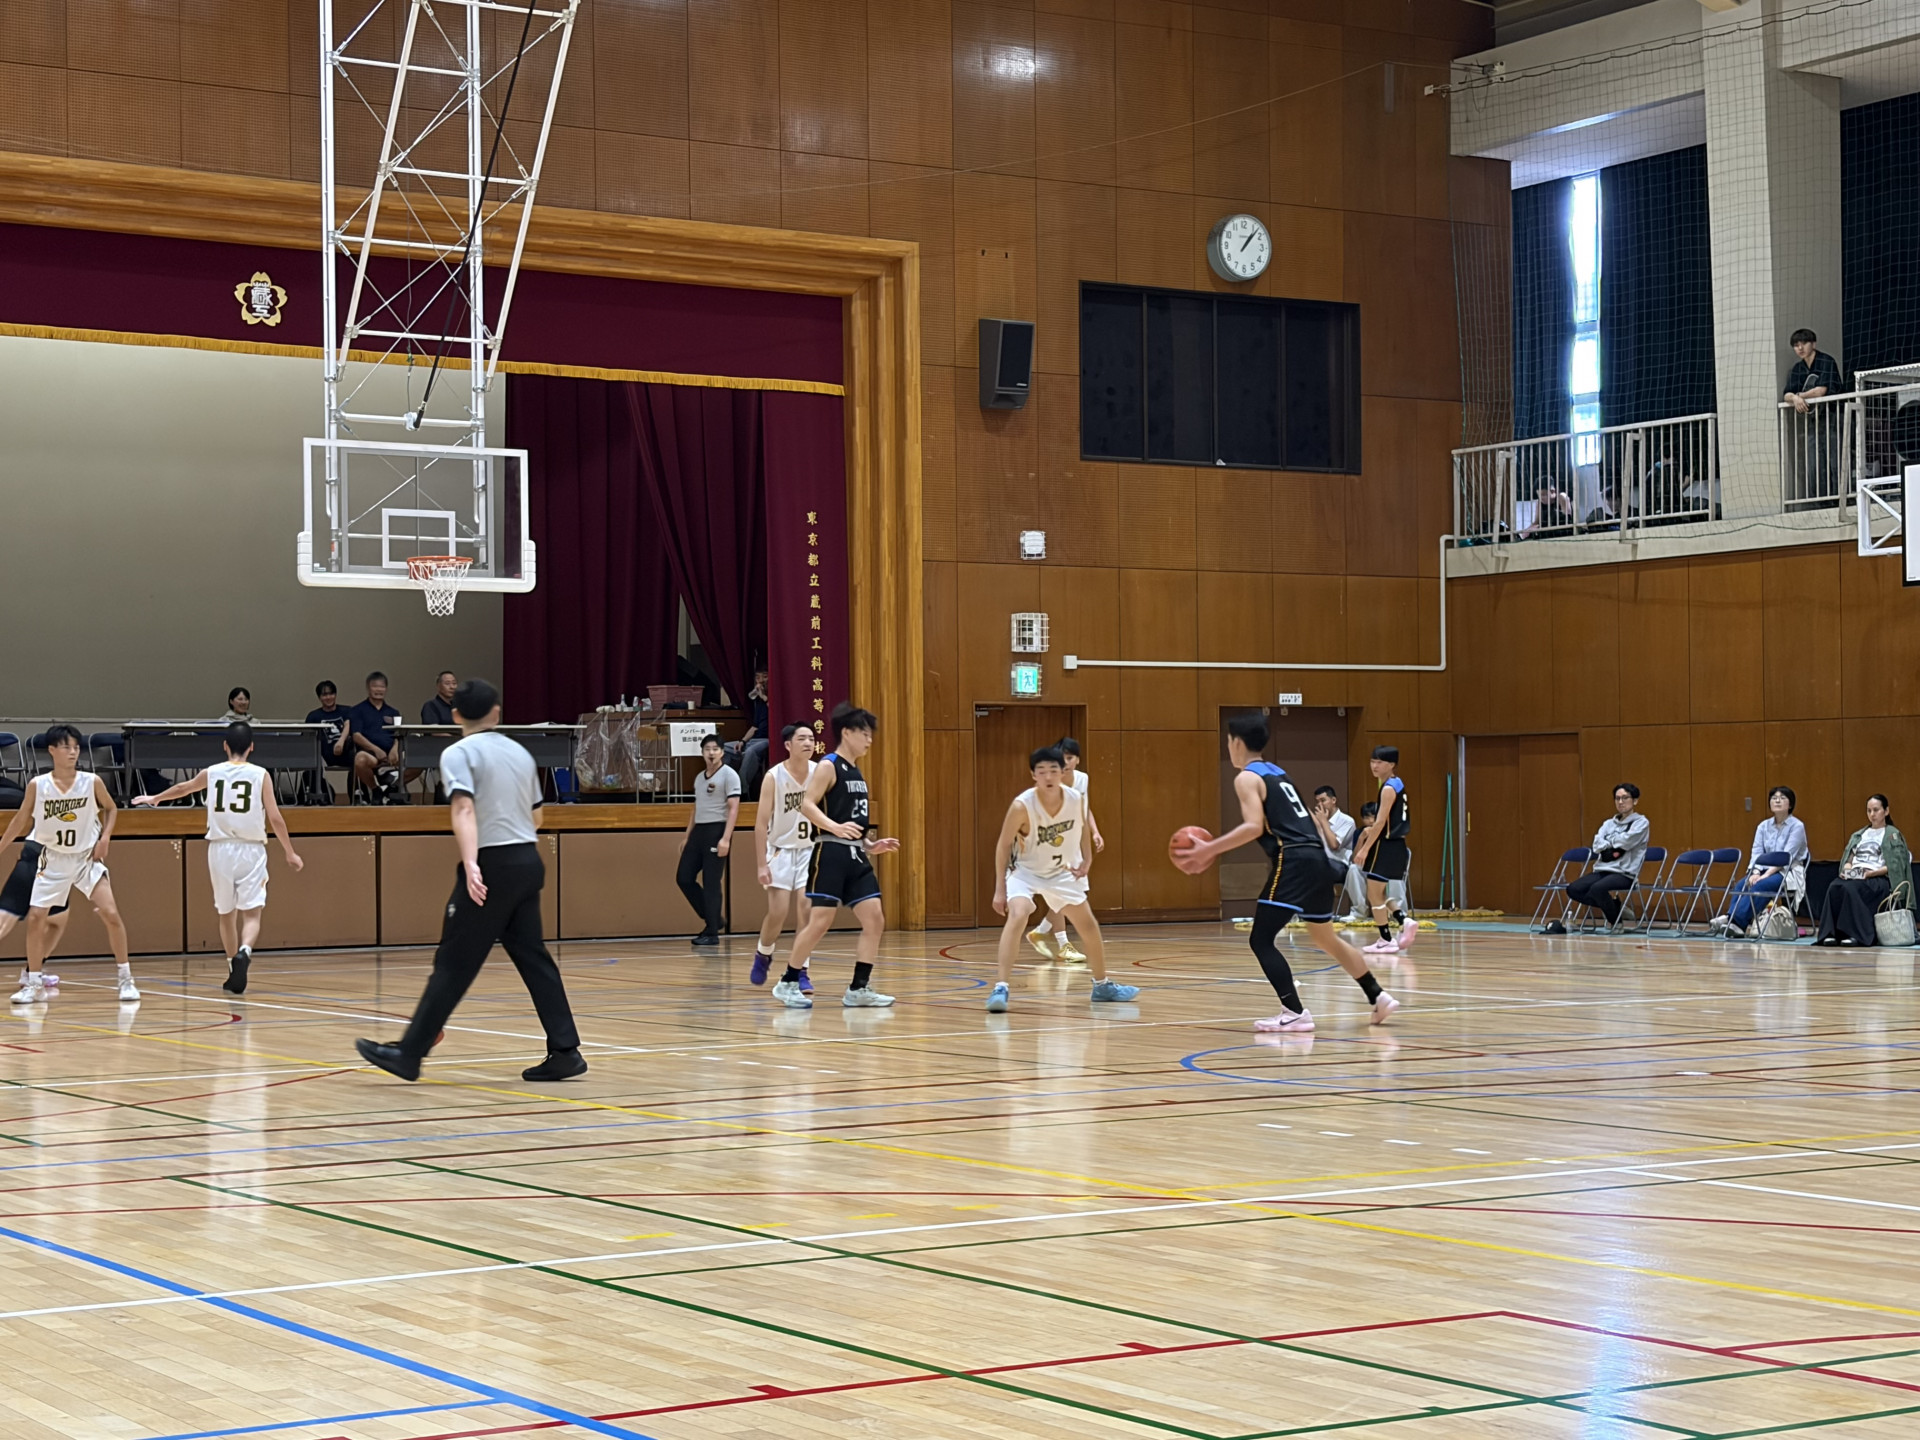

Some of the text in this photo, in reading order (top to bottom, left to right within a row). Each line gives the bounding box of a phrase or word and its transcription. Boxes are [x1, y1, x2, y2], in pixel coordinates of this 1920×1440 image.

[1233, 222, 1238, 231] 11
[1241, 220, 1247, 229] 12
[1226, 231, 1231, 239] 10
[1260, 244, 1264, 252] 3
[1227, 253, 1231, 261] 8
[1242, 264, 1246, 273] 6
[807, 511, 826, 755] 東京都立蔵前工科高等学校
[214, 779, 252, 814] 13
[1279, 781, 1309, 818] 9
[798, 821, 808, 839] 9
[56, 829, 76, 847] 10
[1052, 854, 1062, 866] 7
